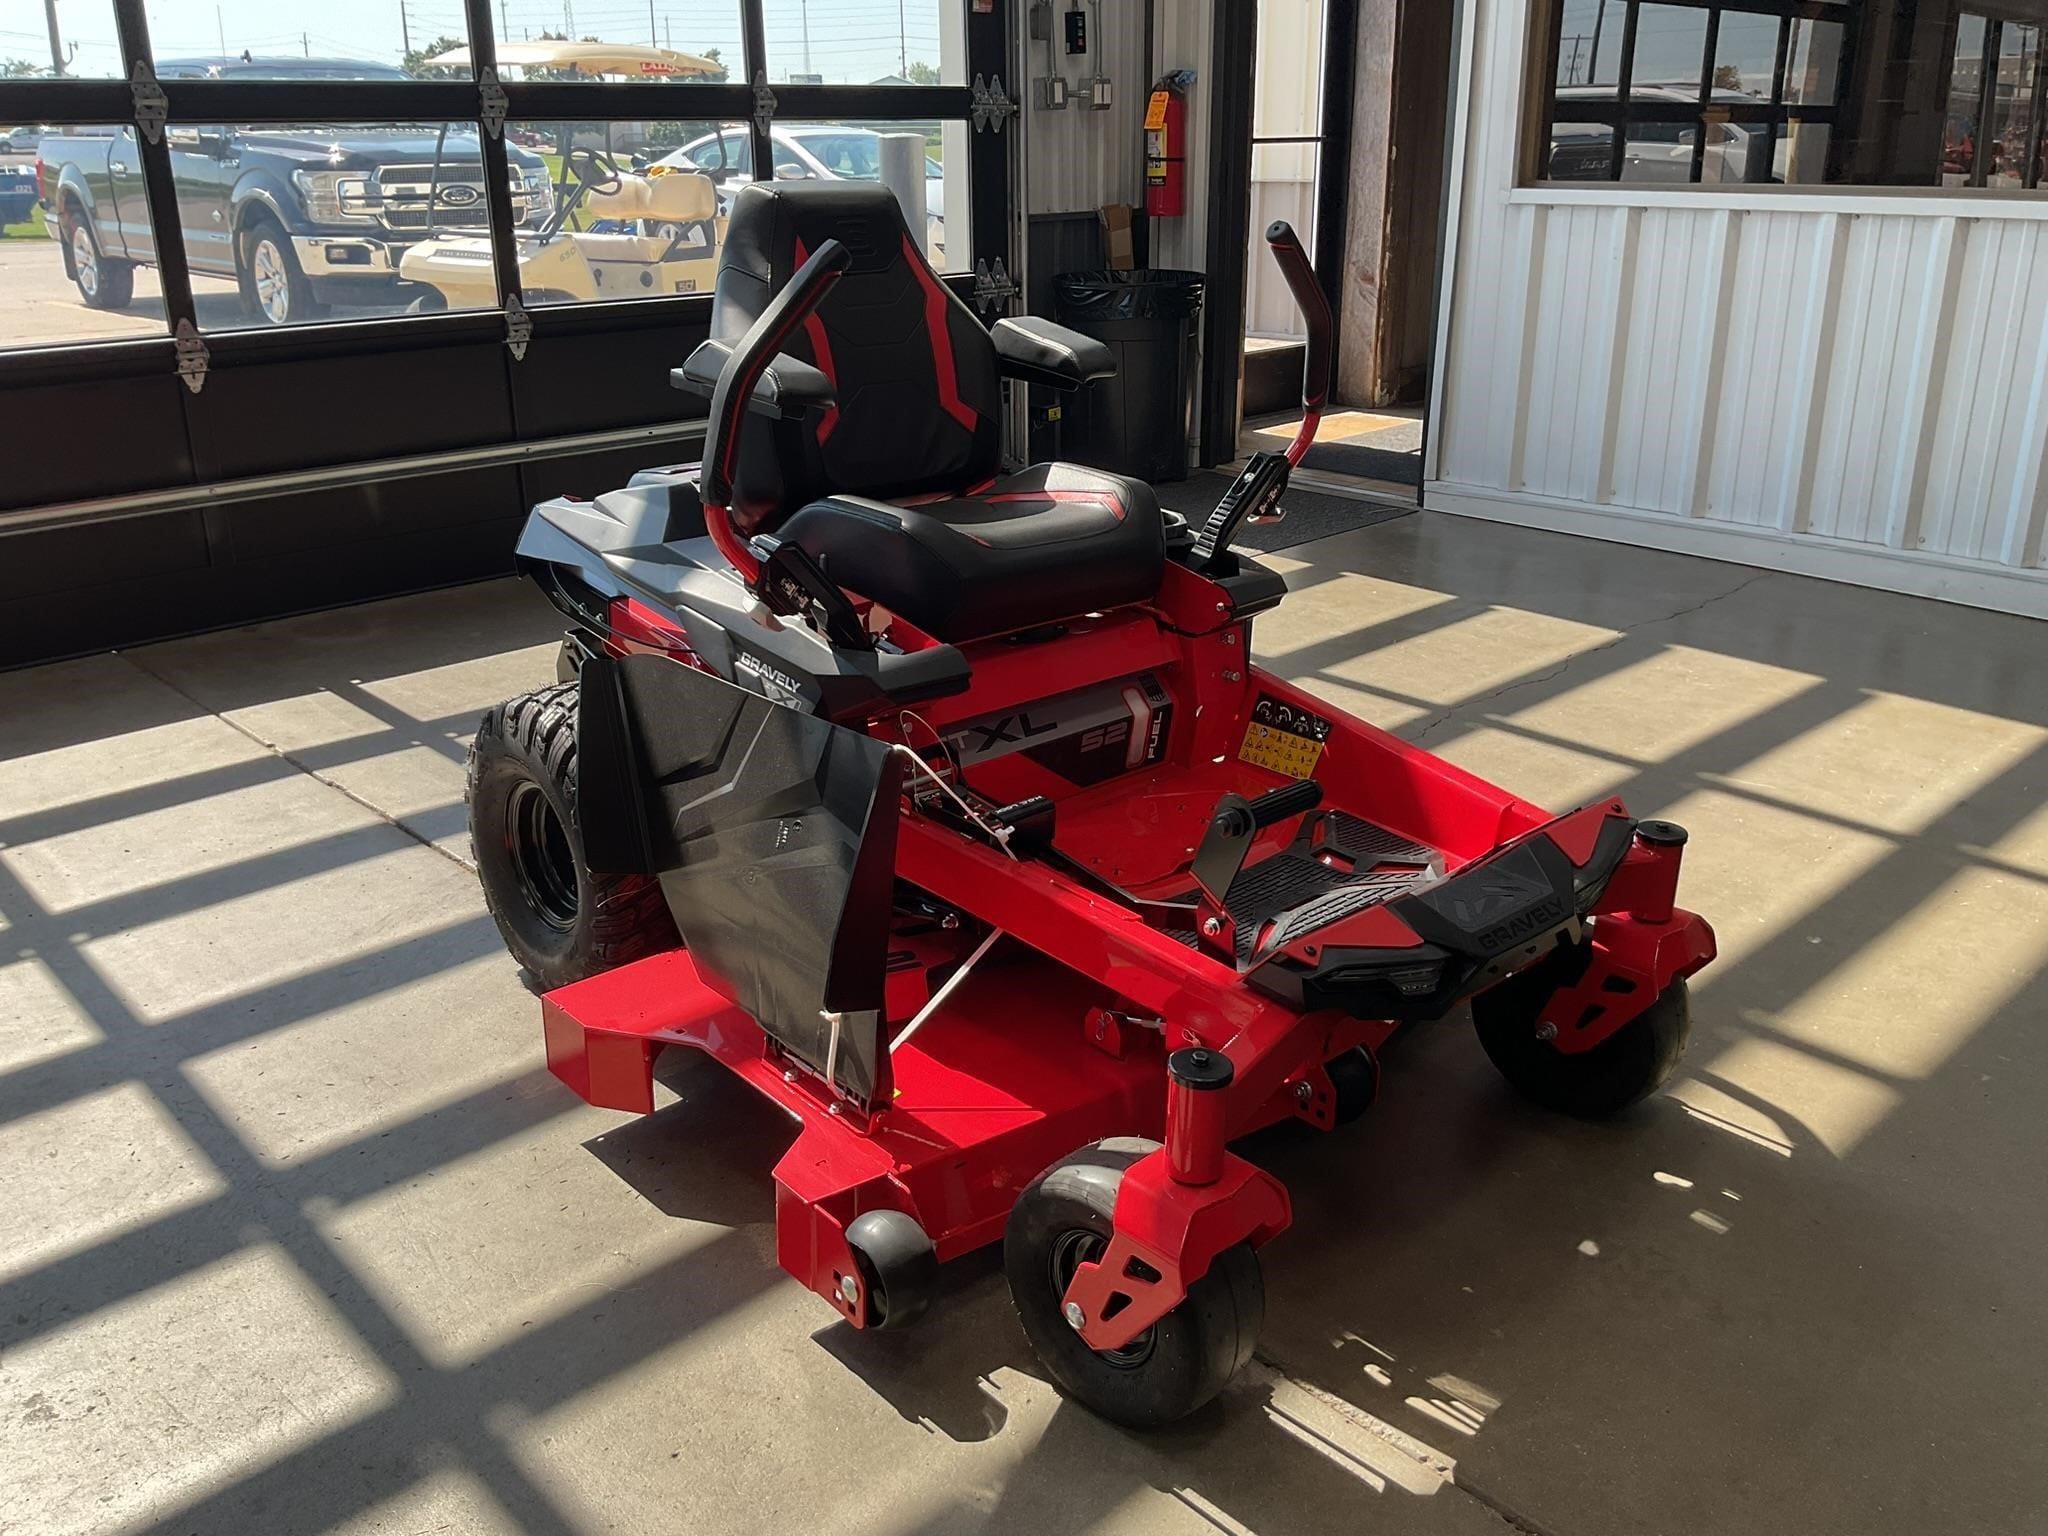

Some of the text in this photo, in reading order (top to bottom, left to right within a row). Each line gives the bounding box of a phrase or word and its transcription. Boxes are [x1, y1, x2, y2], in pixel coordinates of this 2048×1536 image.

[740, 651, 802, 694] GRAVELY
[1080, 721, 1128, 753] 52
[1478, 899, 1565, 949] GRAVELY
